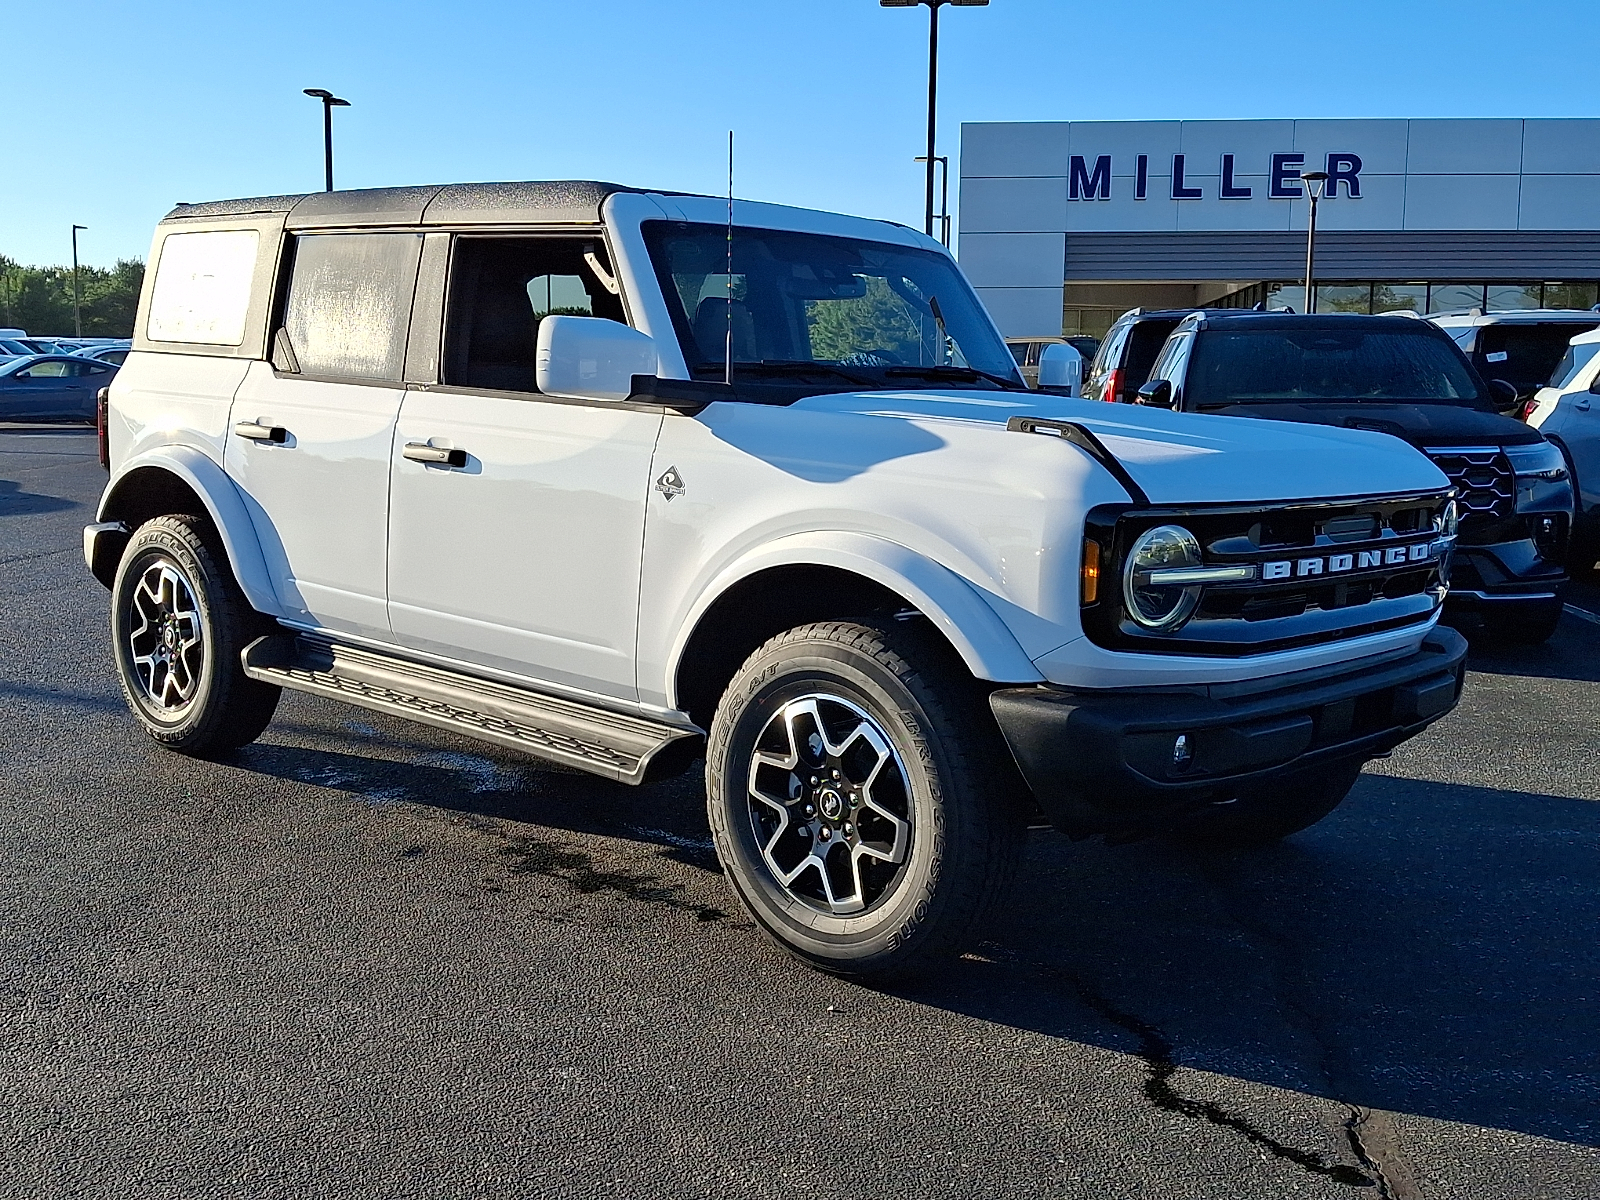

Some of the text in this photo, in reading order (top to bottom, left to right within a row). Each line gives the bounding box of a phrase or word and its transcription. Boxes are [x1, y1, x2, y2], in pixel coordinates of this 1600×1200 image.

[1067, 152, 1363, 200] MILLER
[1262, 543, 1429, 579] BRONCO
[886, 709, 947, 951] BRIDGESTONE
